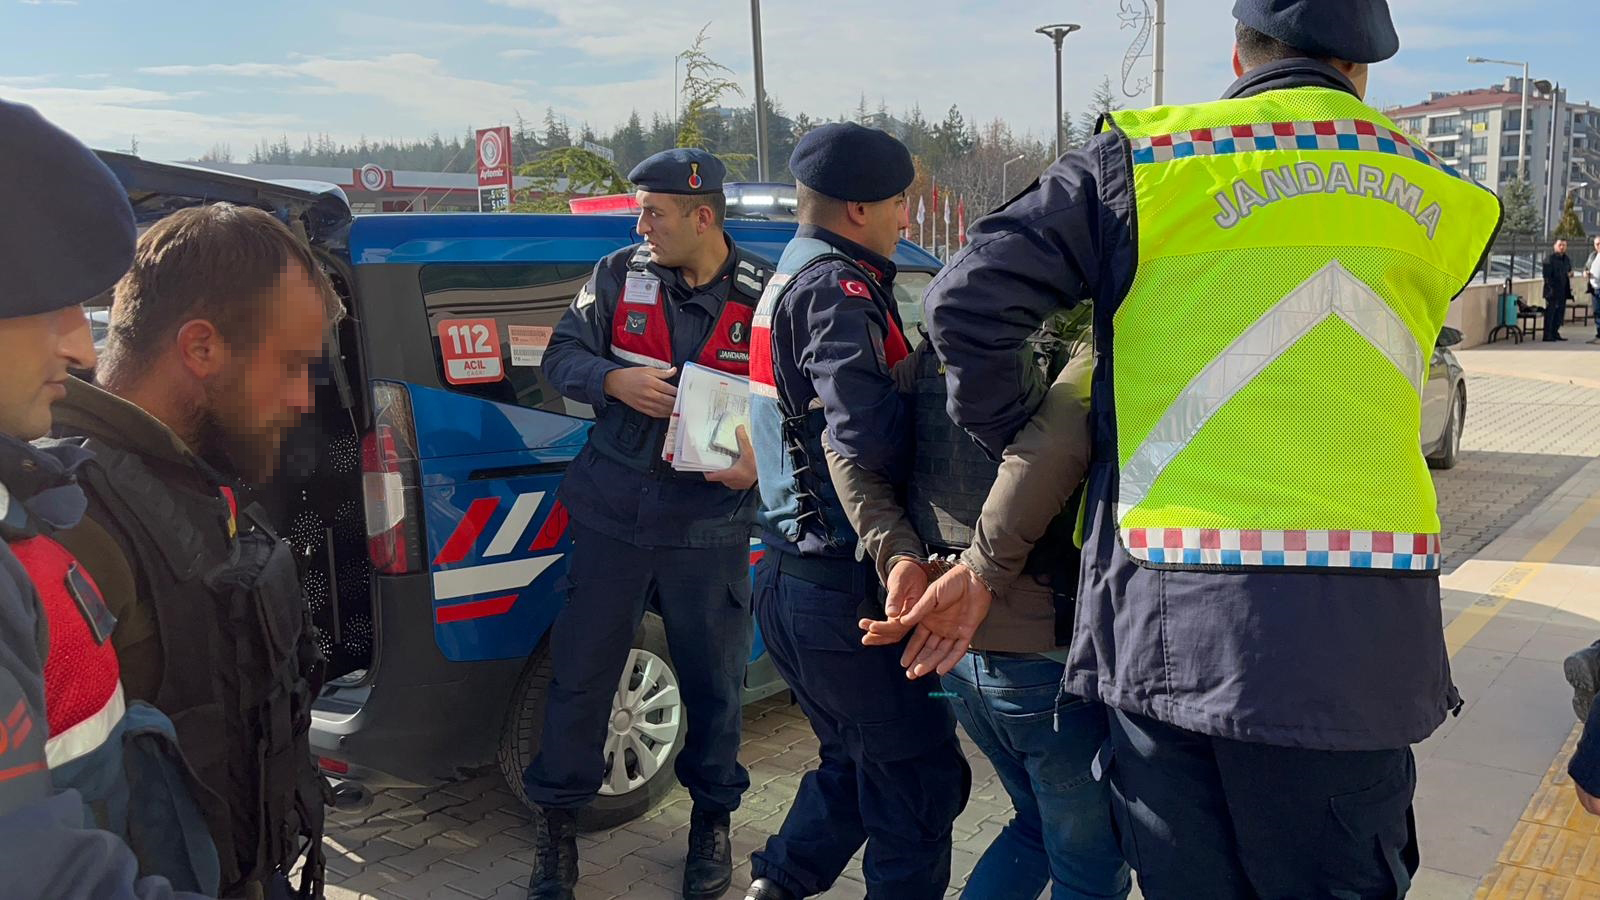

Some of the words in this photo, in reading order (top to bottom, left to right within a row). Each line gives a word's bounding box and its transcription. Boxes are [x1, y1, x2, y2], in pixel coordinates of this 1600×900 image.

[1213, 162, 1442, 240] JANDARMA
[448, 324, 492, 354] 112
[720, 350, 749, 361] JANDARM
